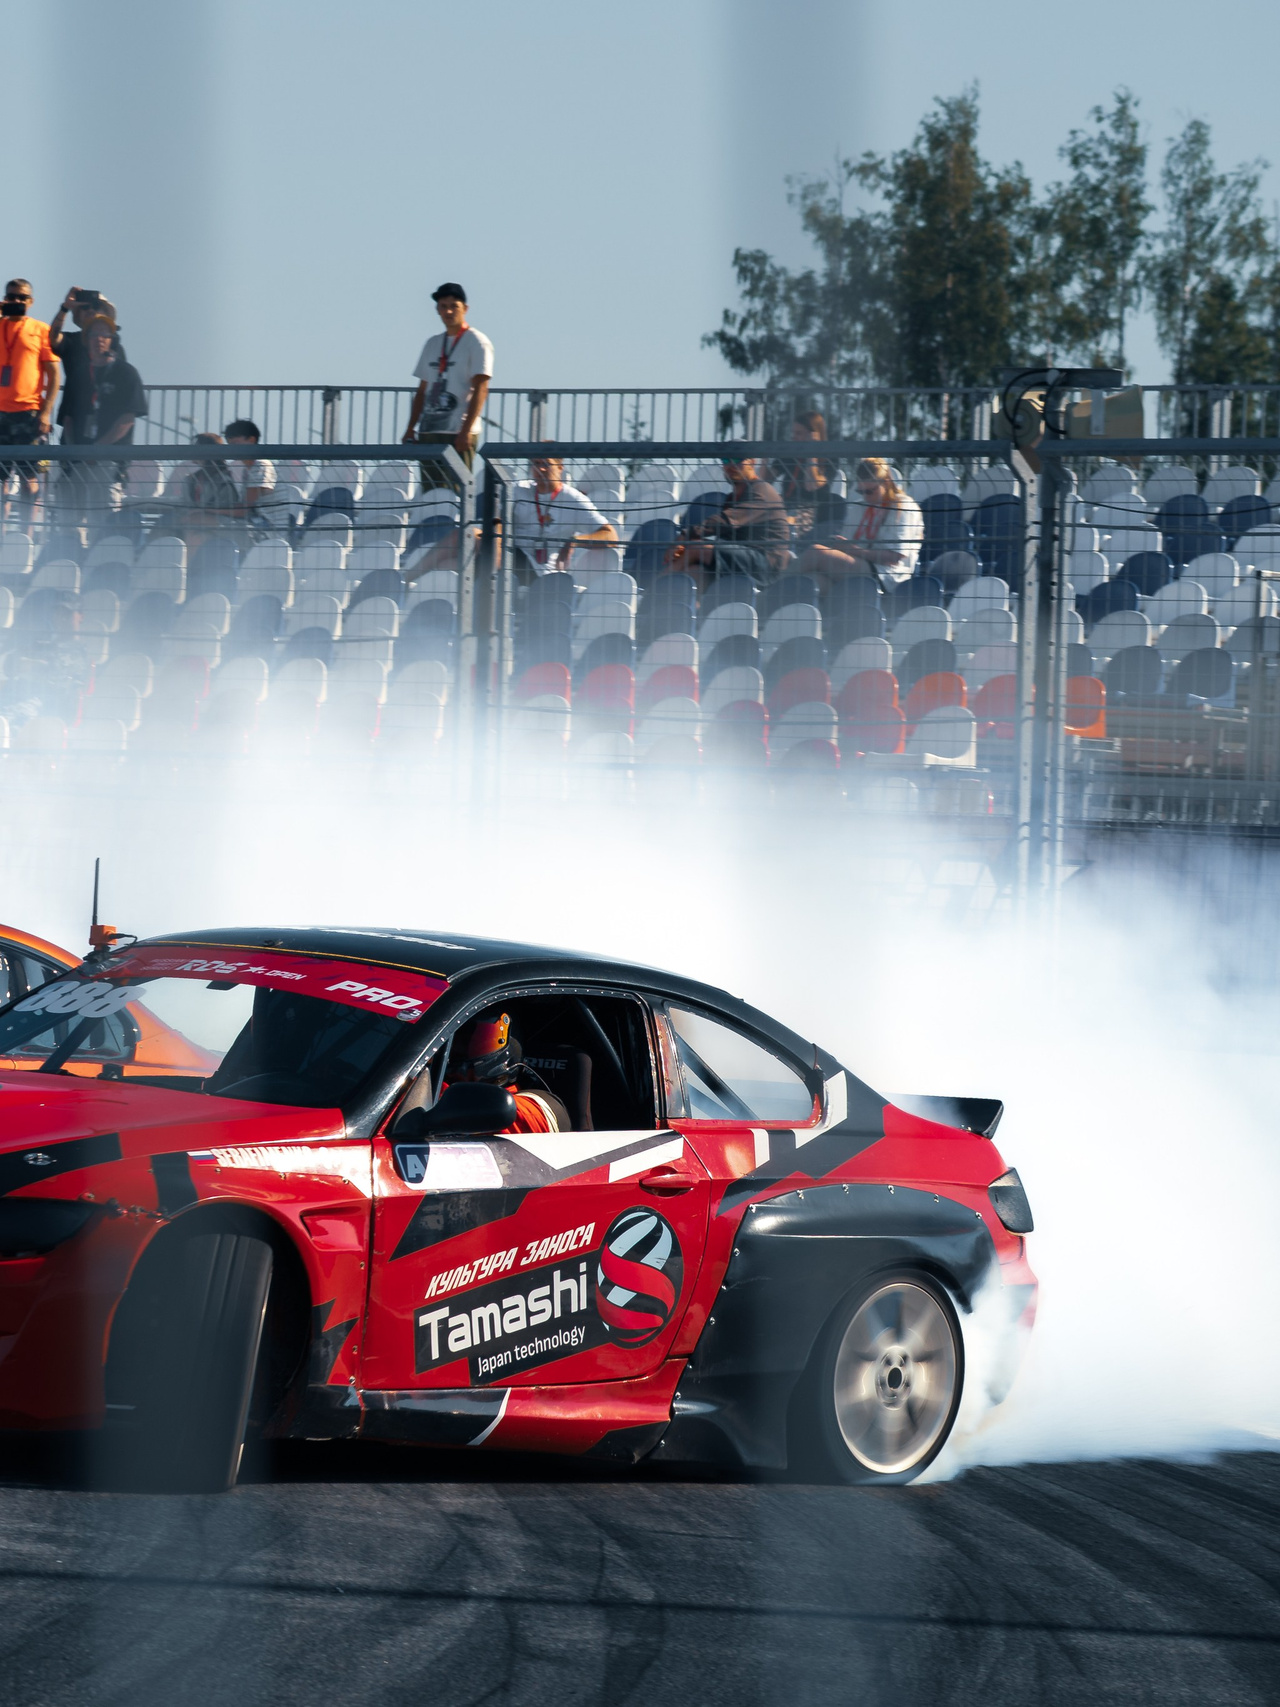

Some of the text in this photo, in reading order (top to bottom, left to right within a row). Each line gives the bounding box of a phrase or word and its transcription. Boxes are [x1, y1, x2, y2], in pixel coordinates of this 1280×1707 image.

[12, 980, 147, 1019] 888
[265, 969, 307, 981] OPEN
[325, 980, 423, 1010] PRO
[424, 1222, 596, 1299] КУЛЬТУРА ЗАНОСА
[419, 1262, 587, 1360] Tamashi
[514, 1326, 586, 1361] technology
